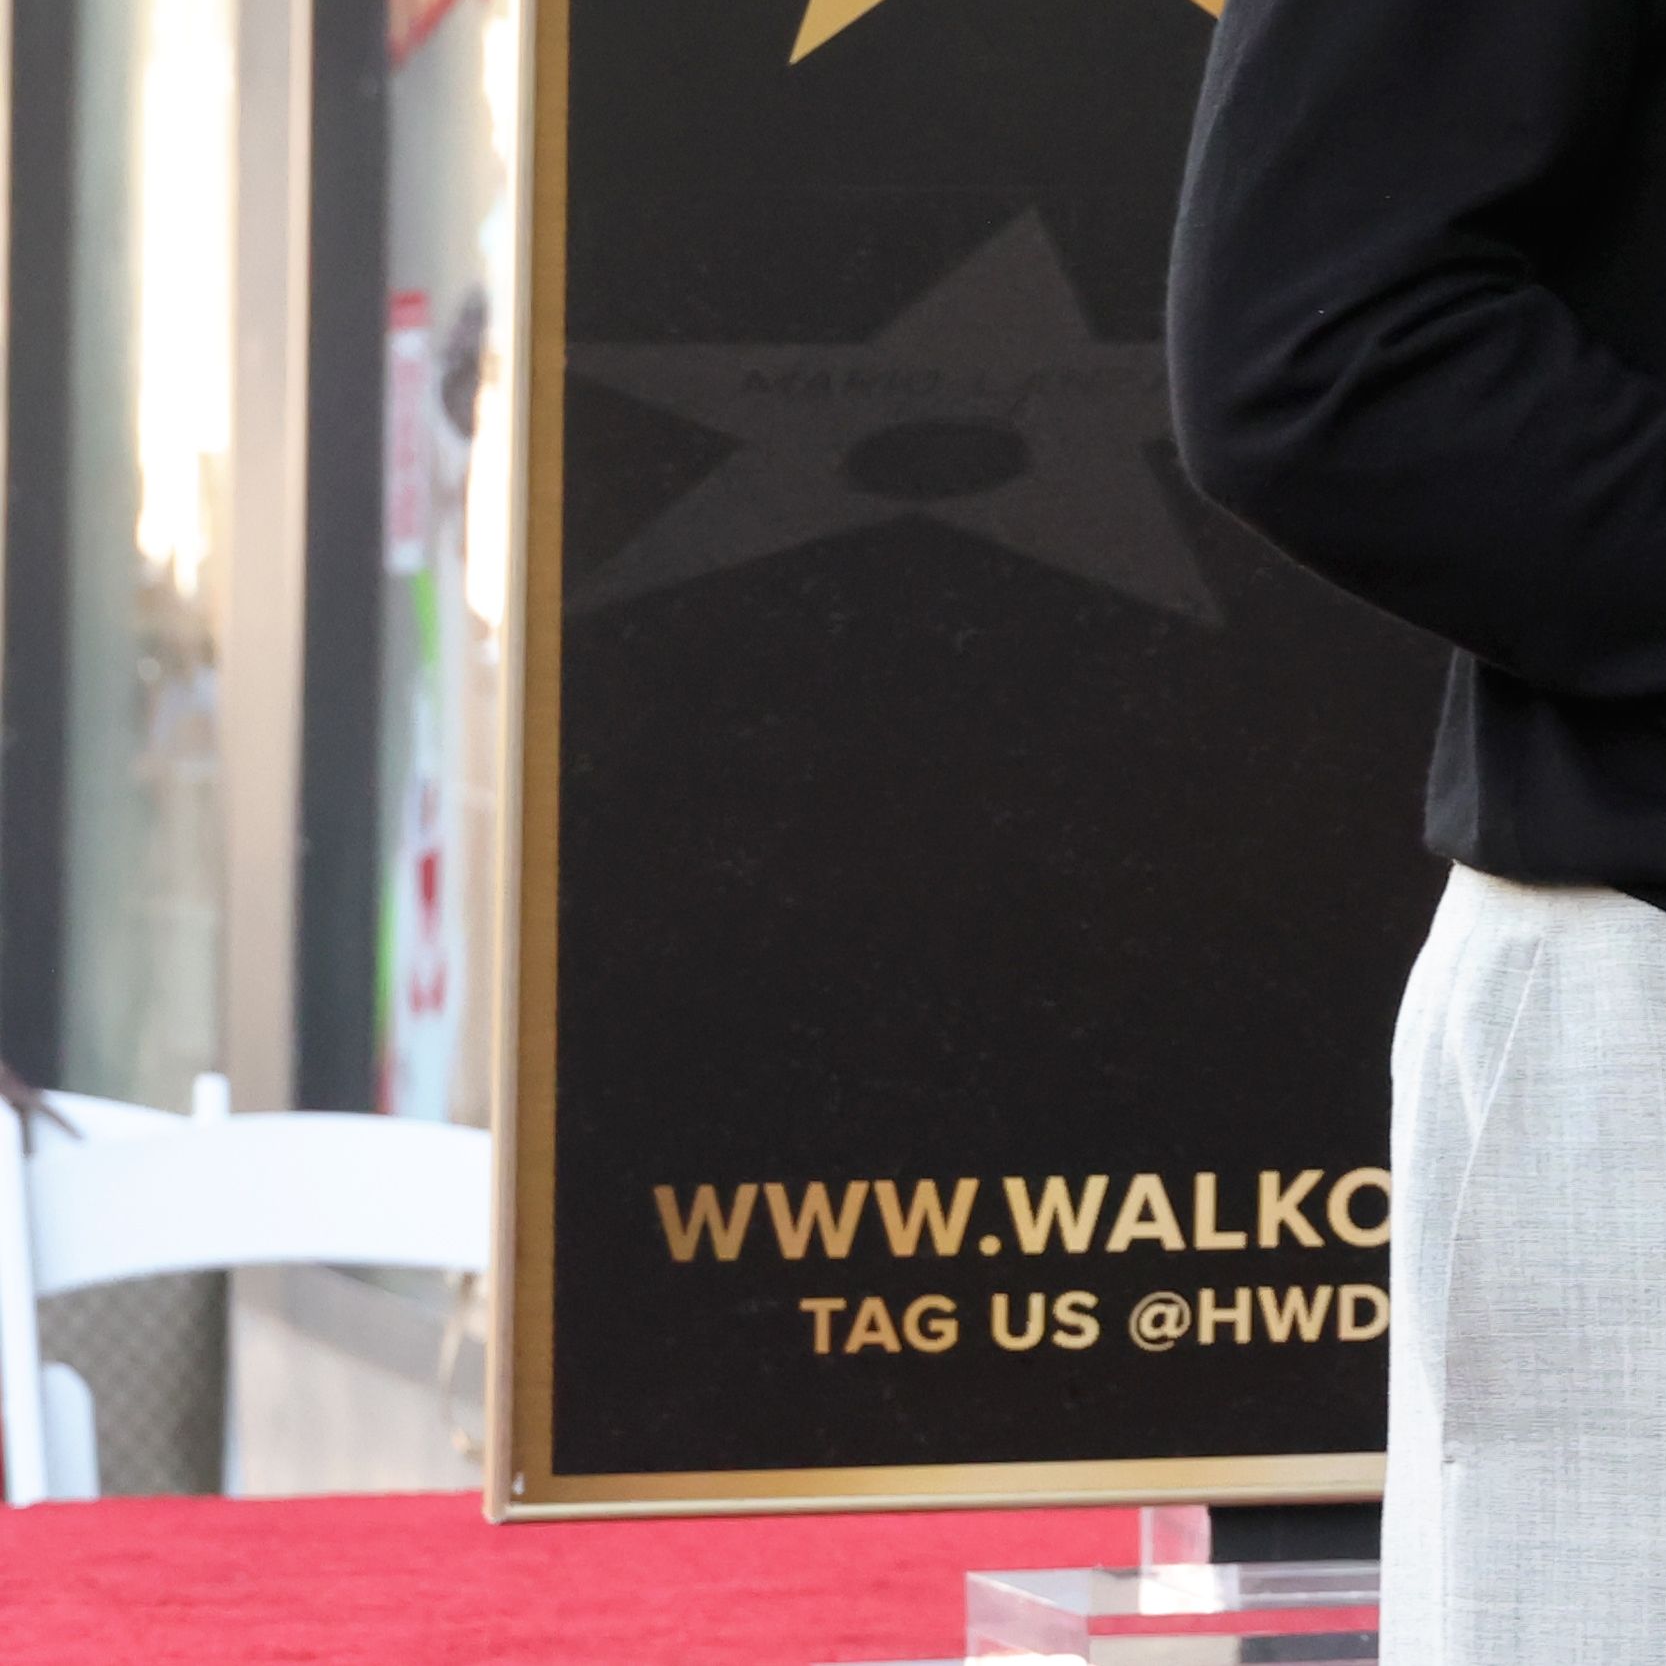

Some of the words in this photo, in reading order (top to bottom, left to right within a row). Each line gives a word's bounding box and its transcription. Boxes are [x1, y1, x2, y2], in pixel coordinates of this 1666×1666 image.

[653, 1166, 1391, 1262] WWW.WALKO
[799, 1295, 959, 1355] TAG
[991, 1291, 1100, 1351] US
[1128, 1283, 1390, 1352] @HWD
